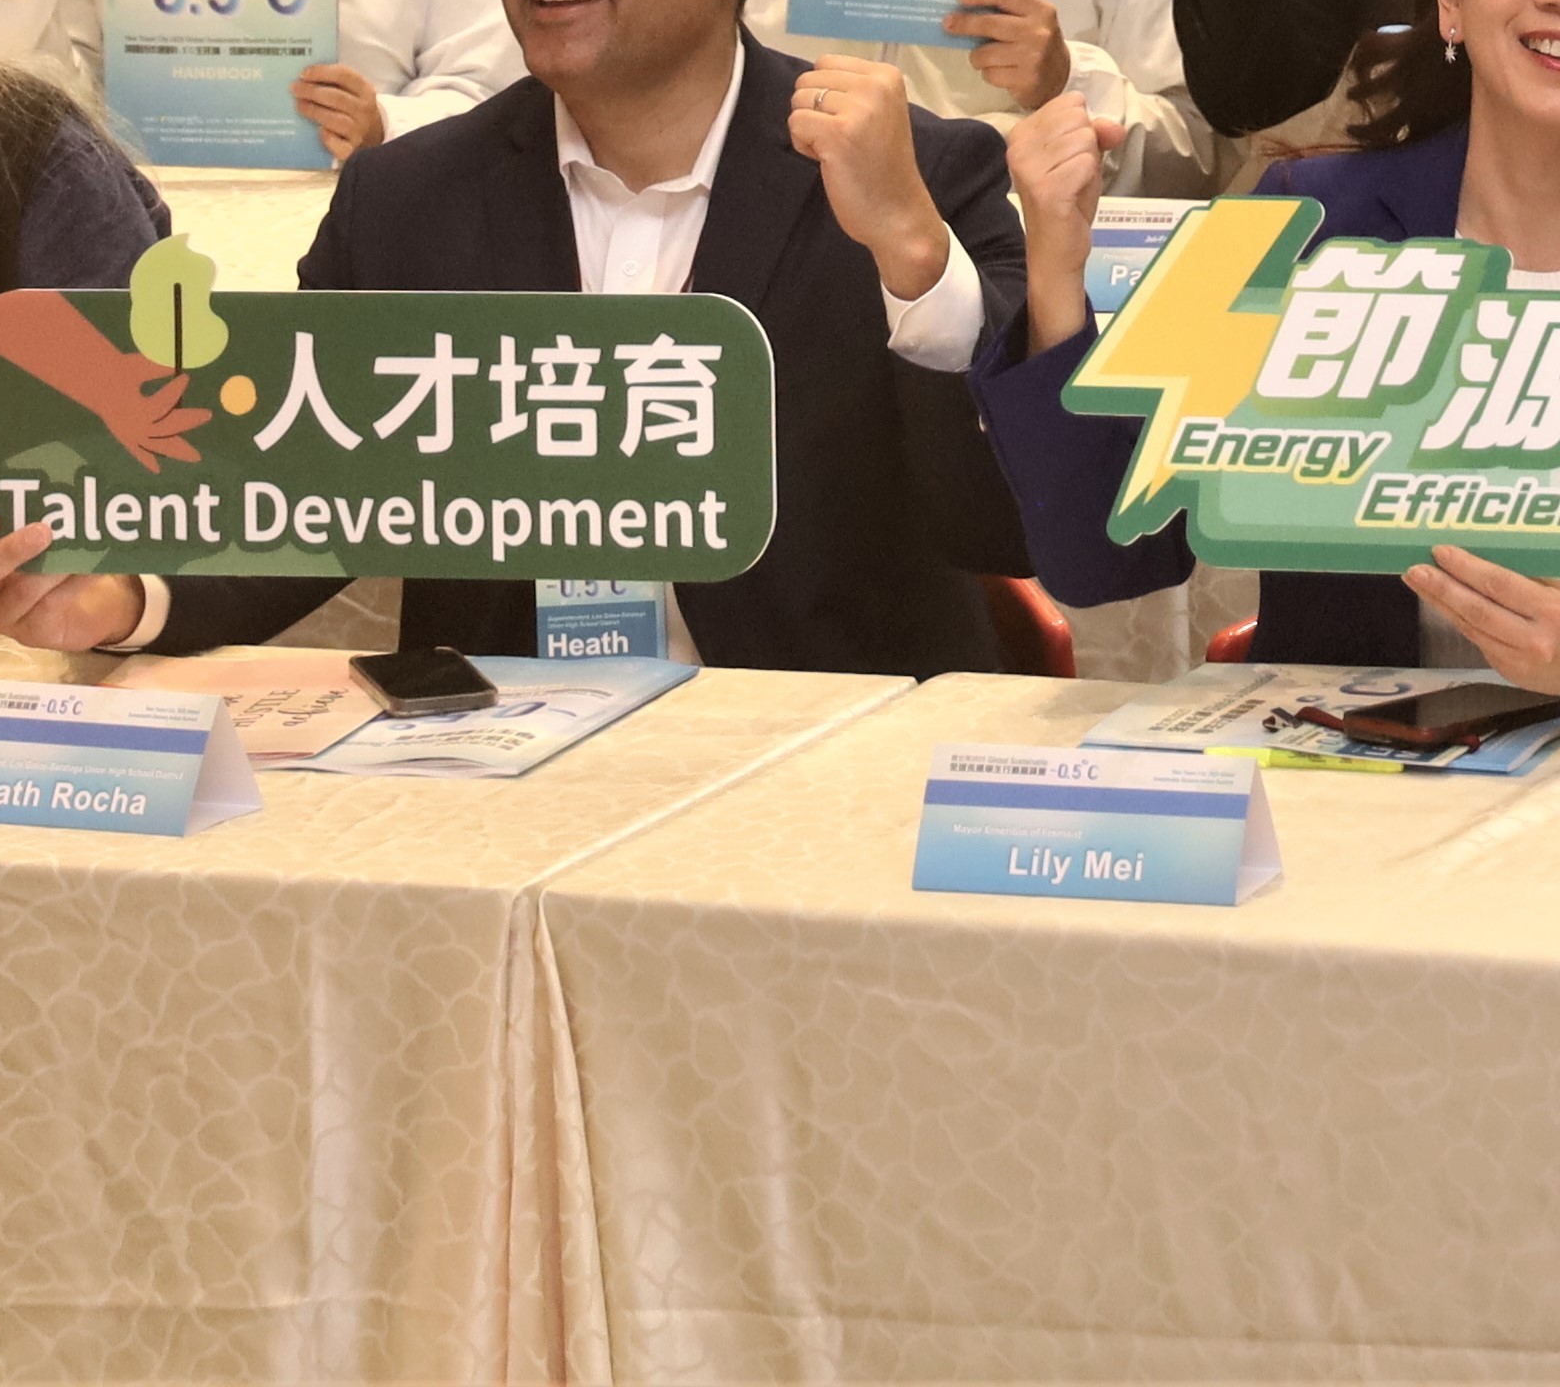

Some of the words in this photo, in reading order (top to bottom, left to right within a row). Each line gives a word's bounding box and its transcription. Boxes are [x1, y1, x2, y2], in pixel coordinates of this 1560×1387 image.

[172, 66, 262, 81] HANDBOOK
[252, 331, 723, 459] 人才培育
[1171, 421, 1386, 480] Energy
[243, 481, 728, 562] Development
[546, 631, 629, 657] Heath
[41, 695, 84, 716] -0.5°C
[1049, 759, 1099, 780] -0.5°C
[50, 781, 147, 815] Rocha
[953, 824, 982, 835] Mayor
[1008, 847, 1072, 885] Lily
[1084, 850, 1145, 881] Mei
